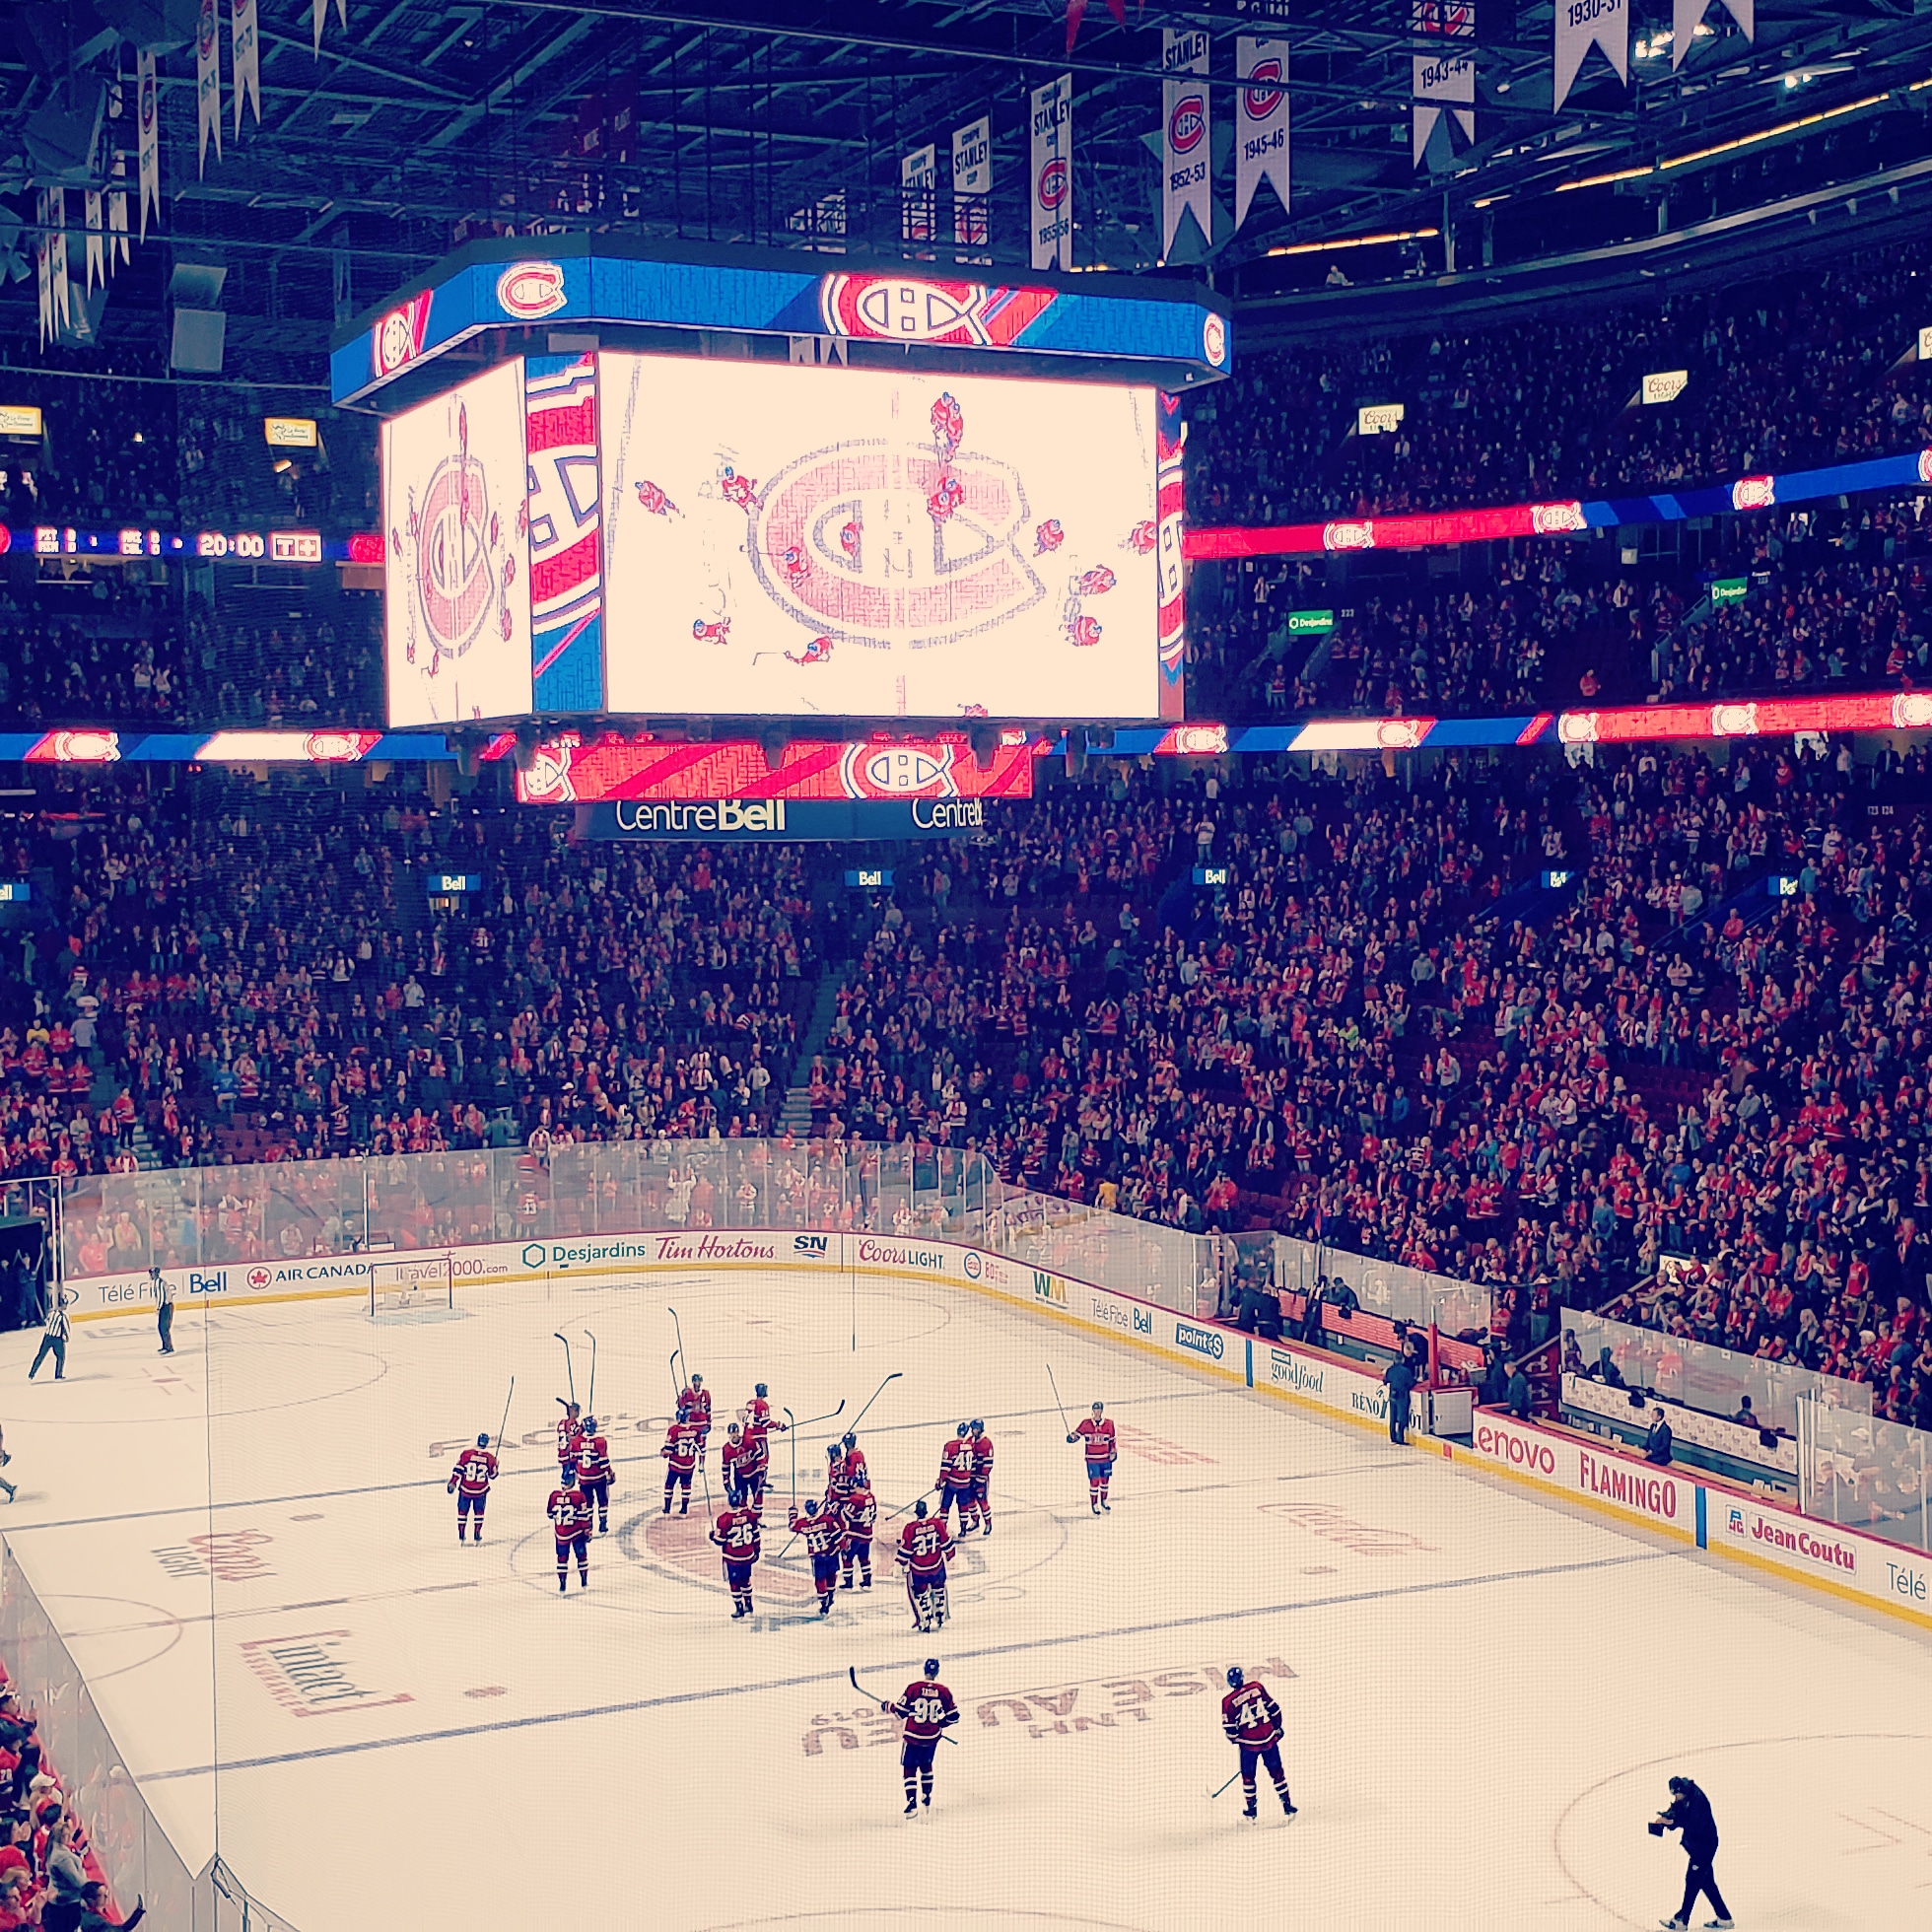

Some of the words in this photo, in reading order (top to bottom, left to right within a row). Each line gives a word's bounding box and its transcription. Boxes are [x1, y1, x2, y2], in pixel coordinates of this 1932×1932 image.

[1165, 33, 1208, 70] STANLEY
[1034, 99, 1070, 137] STANLEY
[955, 140, 988, 174] STANLEY
[1244, 128, 1284, 161] 1945-46
[1170, 162, 1206, 191] 1952-53
[1647, 378, 1683, 392] Coors
[1364, 410, 1398, 425] Coors
[200, 534, 265, 557] 20:00
[616, 799, 786, 832] CentreBell
[442, 875, 466, 891] Bell
[859, 870, 881, 886] Bell
[1205, 869, 1226, 884] Bell
[0, 884, 13, 902] ell
[553, 1242, 646, 1263] Desjardins
[656, 1235, 693, 1260] Tim
[697, 1234, 775, 1260] Hortons
[794, 1235, 828, 1252] SN
[859, 1239, 907, 1265] Coors
[908, 1250, 943, 1270] LIGHT
[99, 1284, 136, 1303] Télé
[138, 1280, 177, 1299] Fie
[189, 1271, 228, 1294] Bell
[276, 1268, 304, 1282] AIR
[1033, 1272, 1069, 1304] WM
[1134, 1307, 1152, 1336] Bell
[1178, 1326, 1207, 1348] point
[1271, 1362, 1324, 1393] goodfood
[1473, 1425, 1555, 1475] enovo
[465, 1461, 489, 1483] 92
[1580, 1450, 1677, 1518] FLAMINGO
[727, 1524, 753, 1548] 26
[808, 1531, 829, 1553] 11
[913, 1532, 939, 1555] 37
[1752, 1517, 1797, 1551] Jean
[1798, 1533, 1855, 1570] Coutu
[1886, 1561, 1927, 1601] Télé
[267, 1640, 381, 1705] intact
[910, 1697, 943, 1724] 90
[976, 1689, 1078, 1729] AU
[1239, 1696, 1272, 1730] 44
